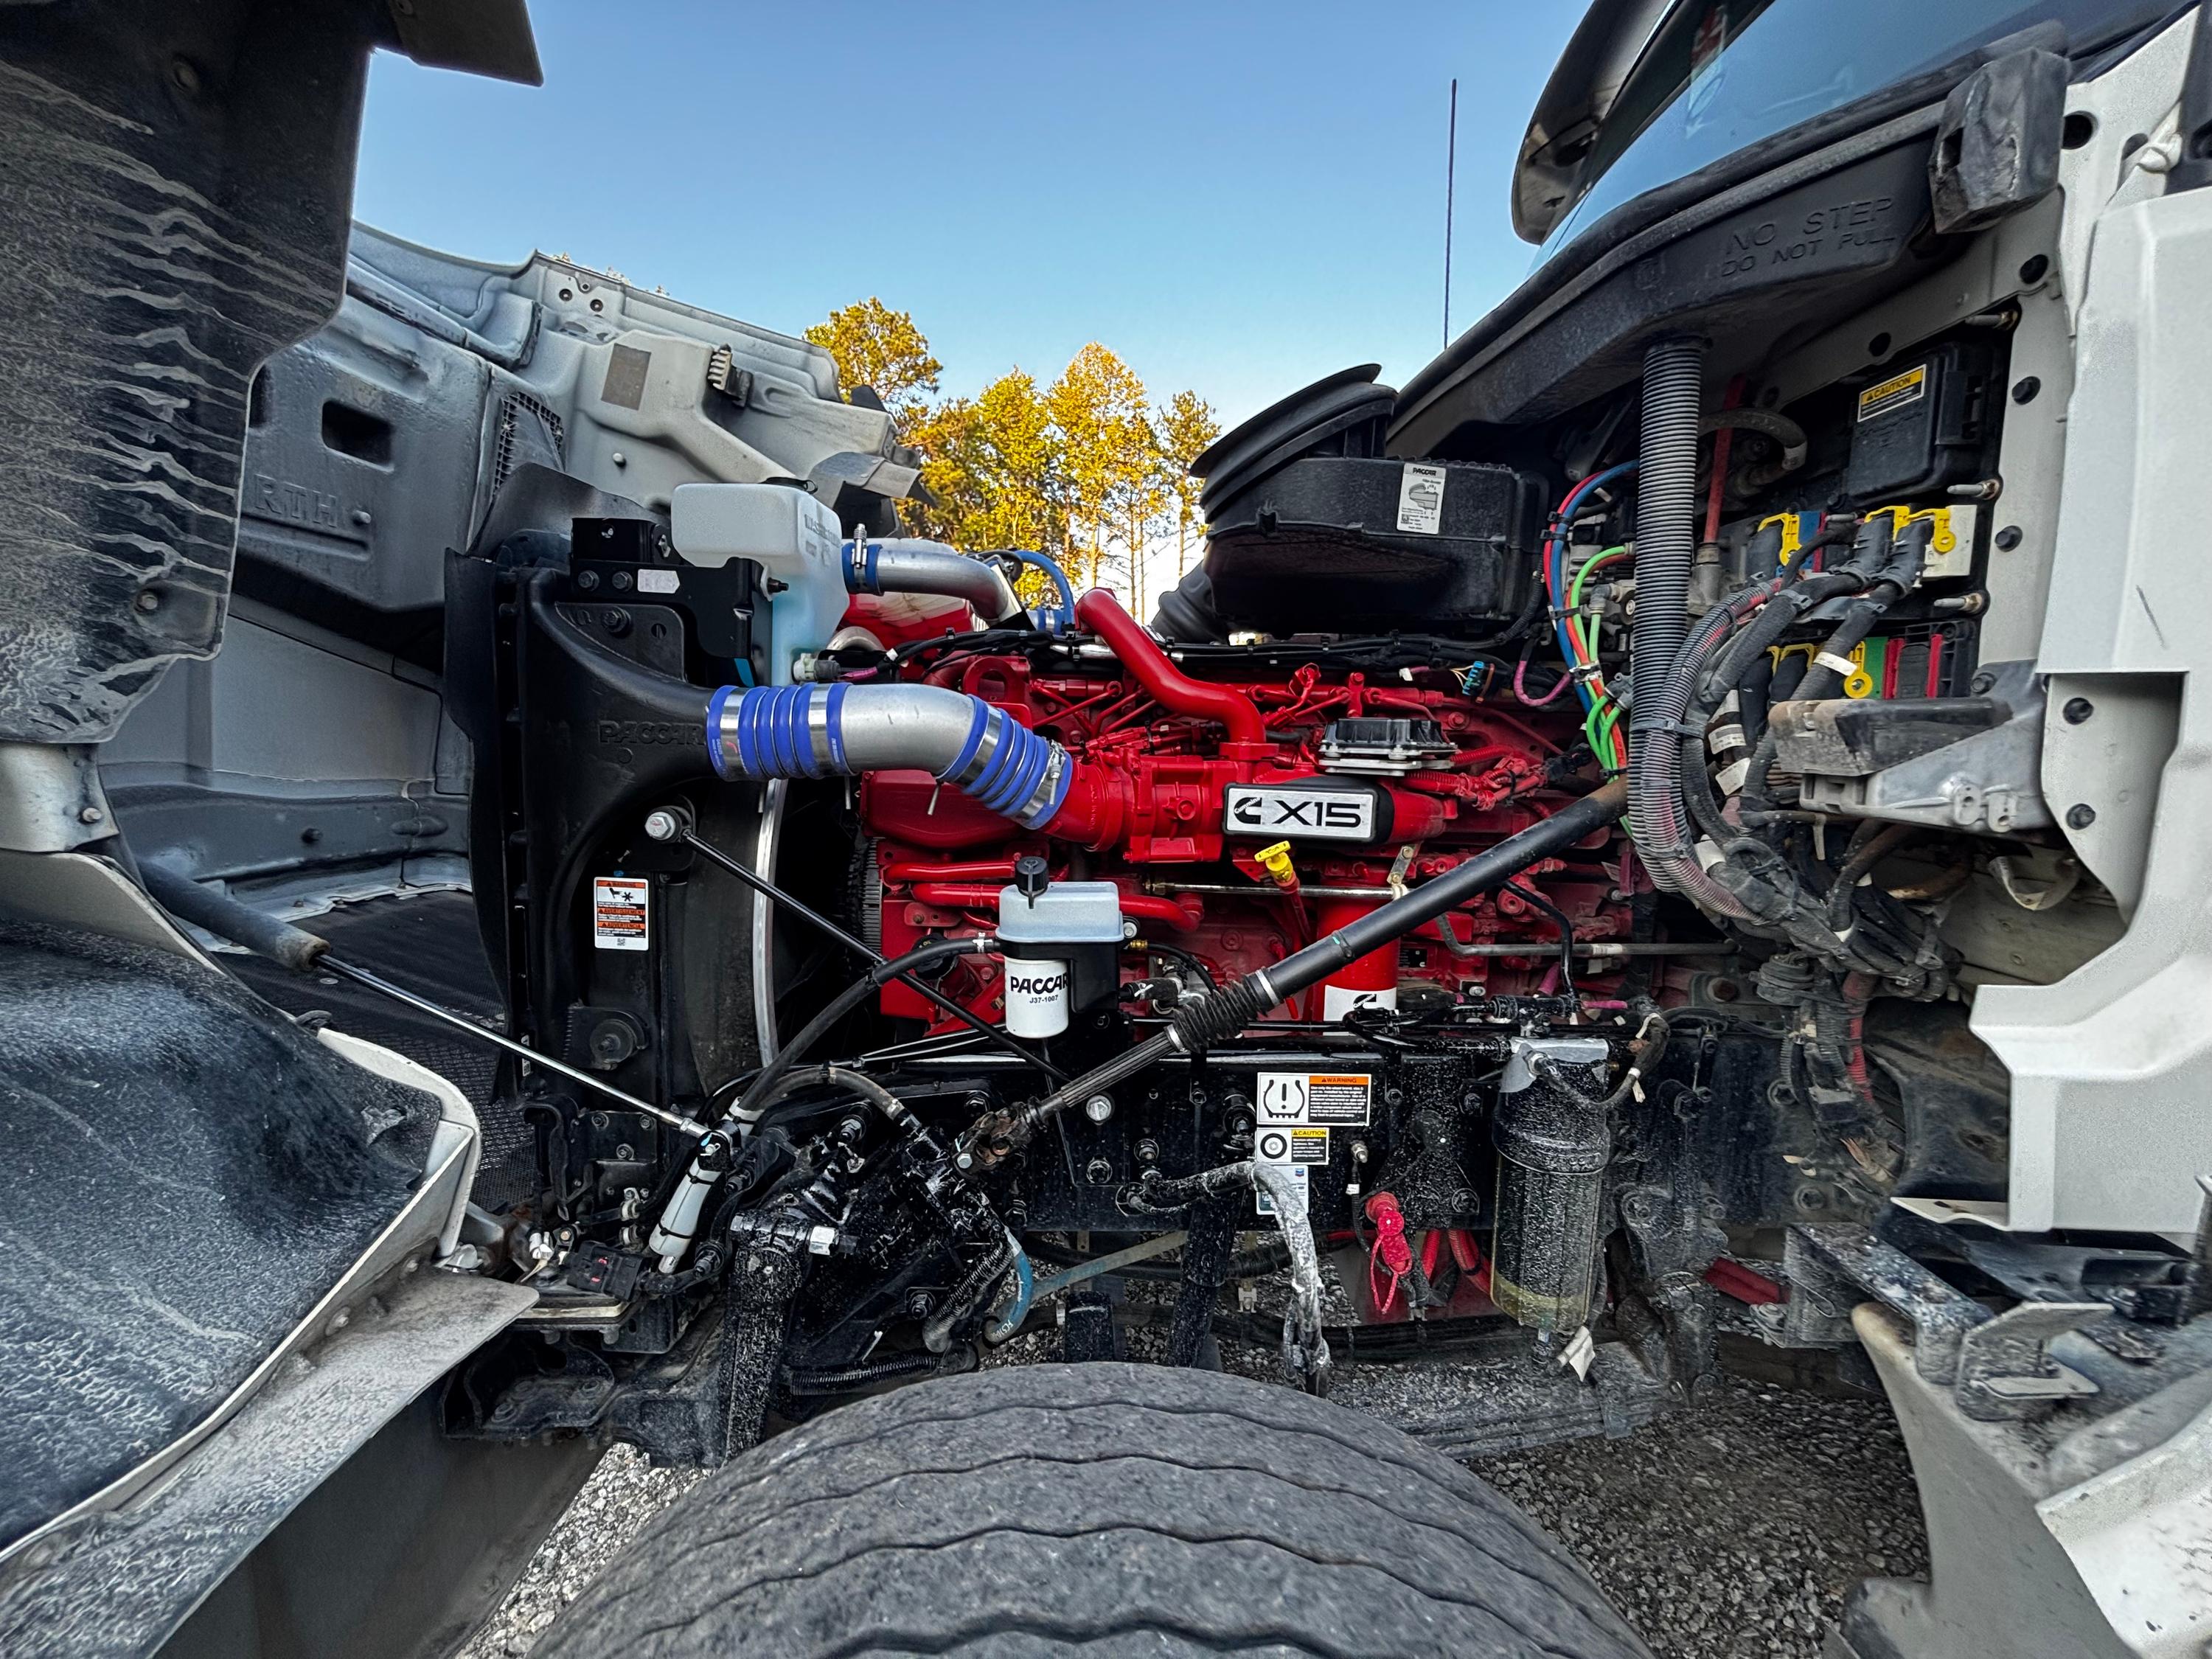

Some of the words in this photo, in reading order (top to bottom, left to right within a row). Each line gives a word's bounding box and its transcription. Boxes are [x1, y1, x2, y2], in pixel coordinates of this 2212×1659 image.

[1726, 223, 1775, 255] NO
[1803, 198, 1893, 234] STEP
[1721, 255, 1755, 277] DO
[1772, 239, 1823, 265] NOT
[1874, 376, 1912, 398] CAUTION
[1413, 467, 1437, 477] PACCAR
[598, 720, 706, 745] PACCAR
[1272, 799, 1361, 828] X15
[1010, 973, 1068, 994] PACCAR
